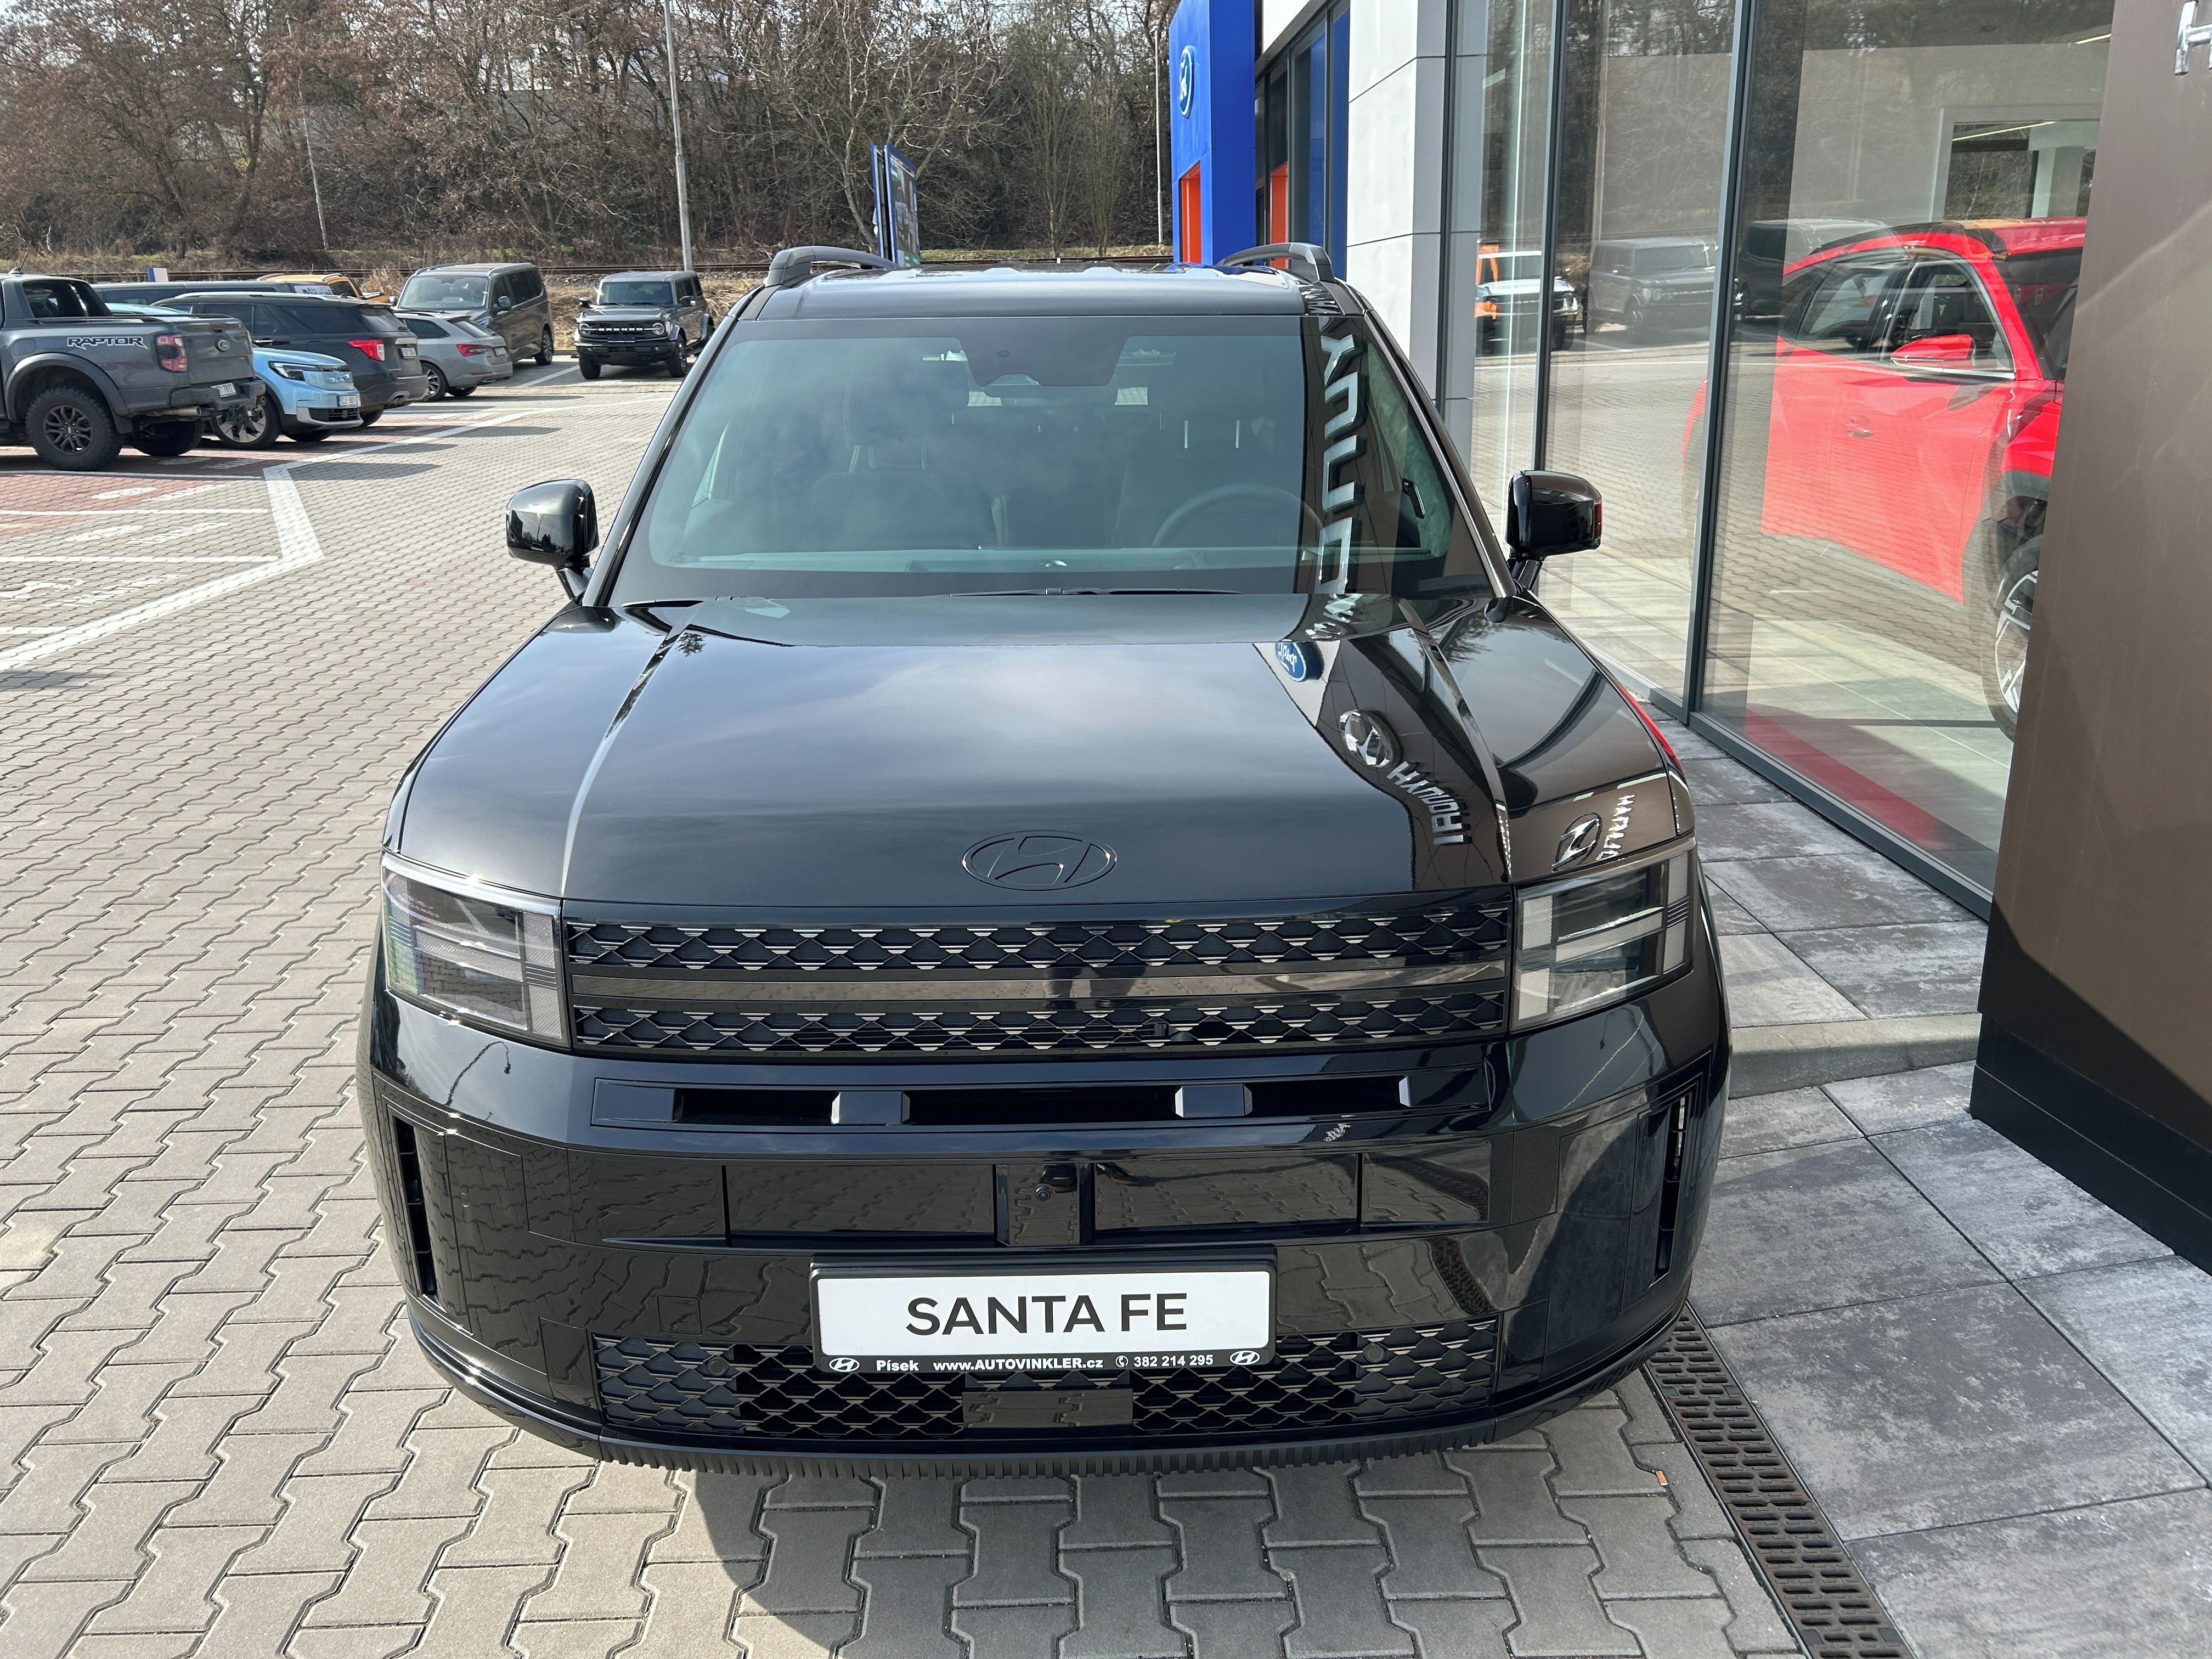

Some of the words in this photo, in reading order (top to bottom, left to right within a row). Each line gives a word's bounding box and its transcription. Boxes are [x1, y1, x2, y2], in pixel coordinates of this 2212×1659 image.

[67, 336, 149, 350] RAPTOR
[906, 1295, 1105, 1335] SANTA
[1121, 1293, 1187, 1331] FE
[876, 1360, 919, 1372] Písek
[933, 1358, 1103, 1371] www.AUTOVINKLER.cz
[1133, 1356, 1158, 1367] 382
[1163, 1355, 1186, 1367] 214
[1189, 1354, 1214, 1365] 295
